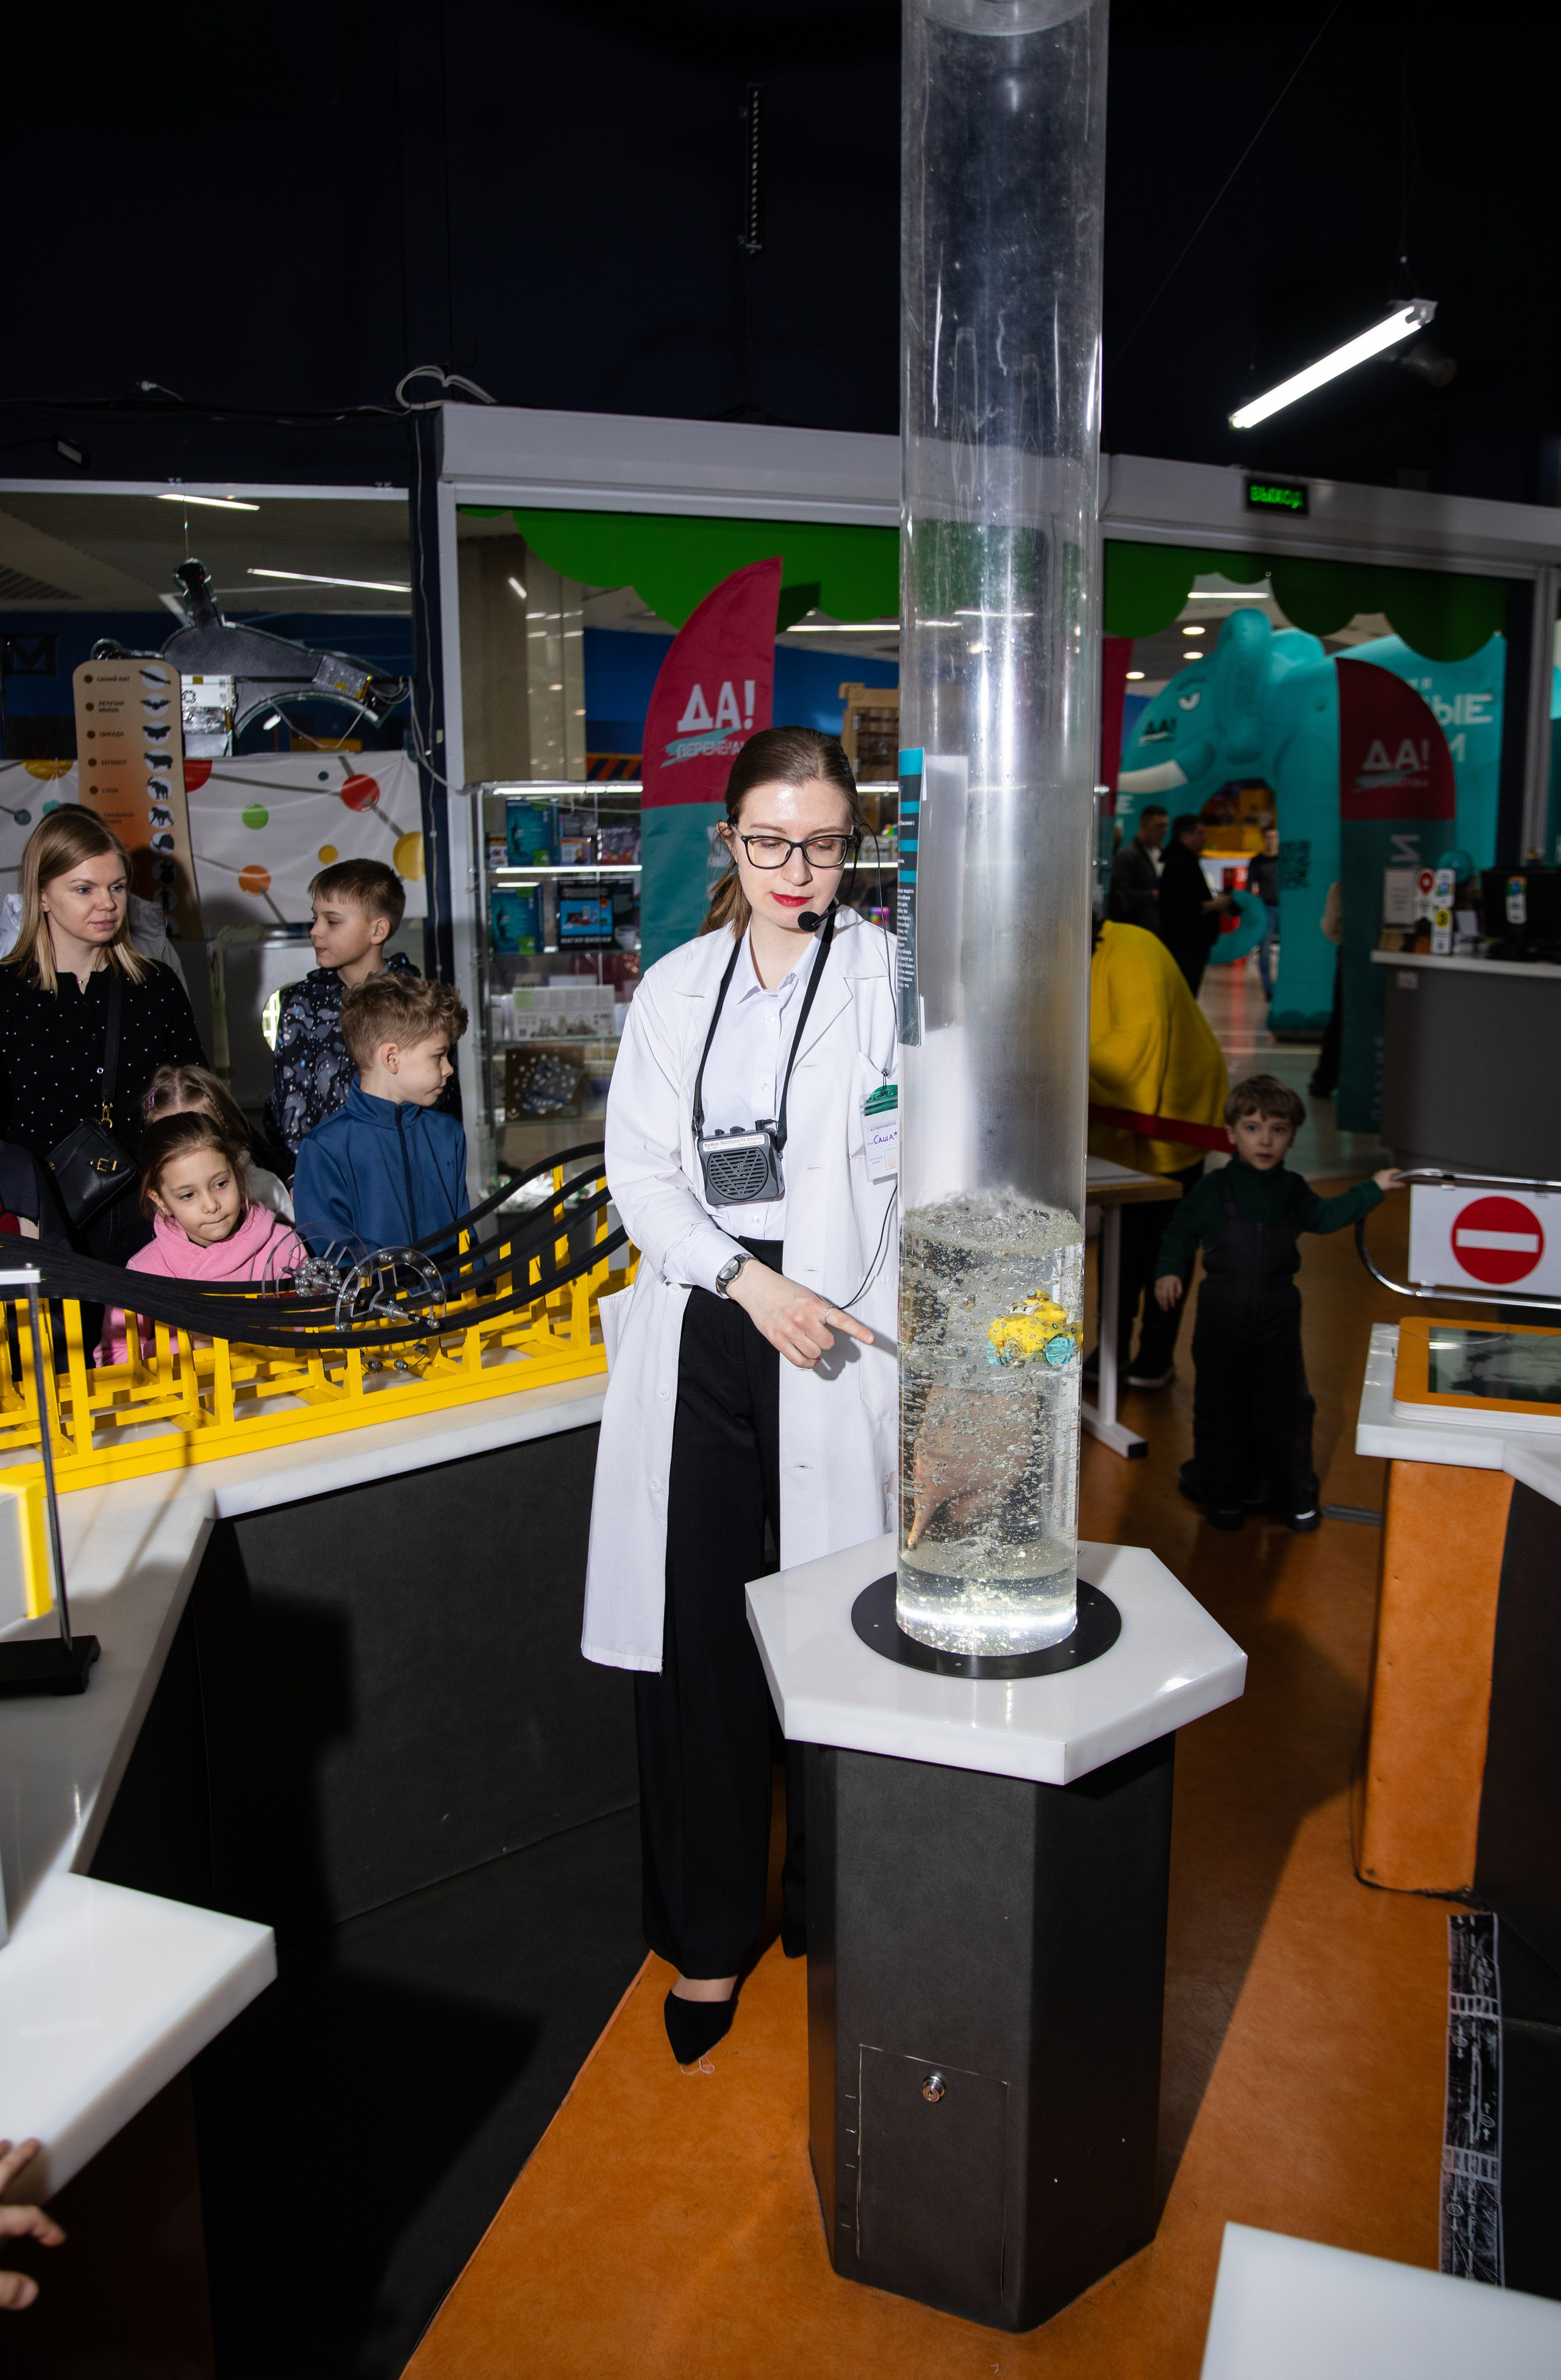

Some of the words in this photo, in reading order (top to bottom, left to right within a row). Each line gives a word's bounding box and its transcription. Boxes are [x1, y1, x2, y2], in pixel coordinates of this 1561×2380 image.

[1249, 485, 1304, 509] ВЫХОД
[677, 679, 755, 733] ДА!
[1361, 739, 1430, 771] ДА!
